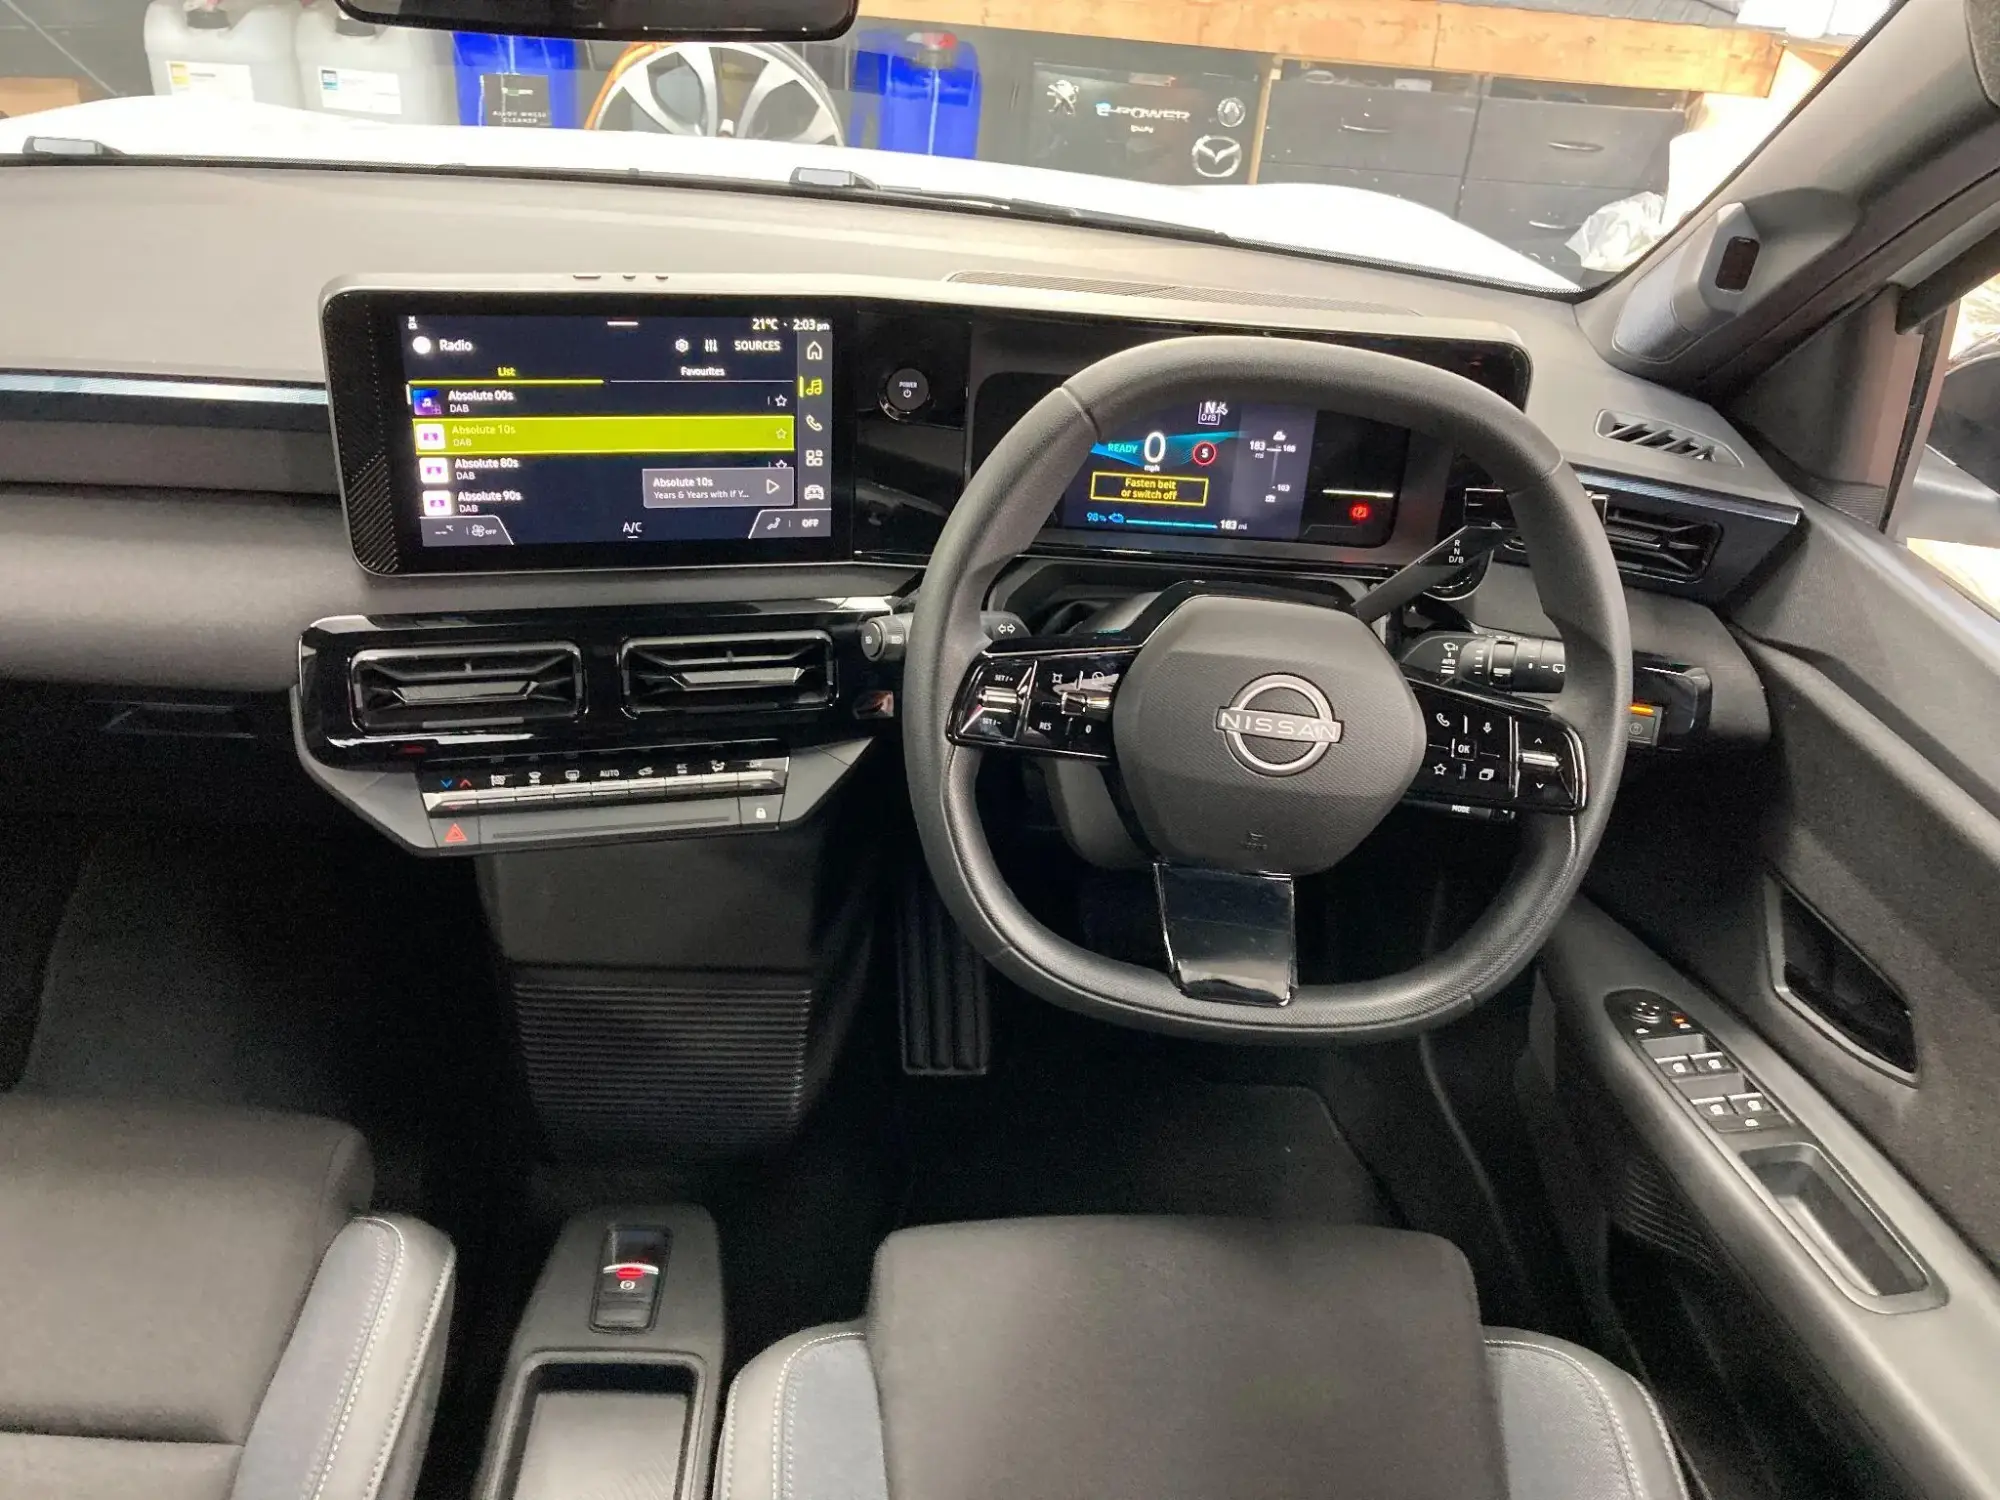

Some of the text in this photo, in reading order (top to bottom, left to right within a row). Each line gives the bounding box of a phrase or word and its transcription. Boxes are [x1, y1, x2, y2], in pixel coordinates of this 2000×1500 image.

[752, 318, 830, 332] 21°C 2:03 pm
[439, 339, 473, 352] Radio
[734, 340, 781, 352] SOURCES
[497, 366, 516, 377] List
[680, 366, 726, 377] Favourites
[449, 389, 514, 402] Absolute 00s
[449, 403, 470, 414] DAB
[452, 424, 516, 435] Absolute 10s
[453, 438, 472, 447] DAB
[1143, 431, 1166, 463] 0
[1107, 443, 1138, 454] READY
[455, 458, 499, 469] Absolute
[1143, 464, 1161, 472] mph
[456, 472, 476, 481] DAB
[653, 477, 713, 488] Absolute 10s
[1125, 477, 1177, 490] Fasten belt
[458, 491, 522, 502] Absolute 90s
[654, 491, 676, 500] Years
[687, 490, 709, 499] Years
[710, 490, 728, 499] with
[1120, 489, 1178, 500] or switch off
[459, 504, 479, 513] DAB
[623, 522, 643, 534] A/C
[801, 518, 820, 528] OFF
[1039, 721, 1052, 731] RES
[1220, 712, 1338, 740] NISSAN
[1457, 744, 1470, 754] OK
[599, 768, 620, 778] AUTO
